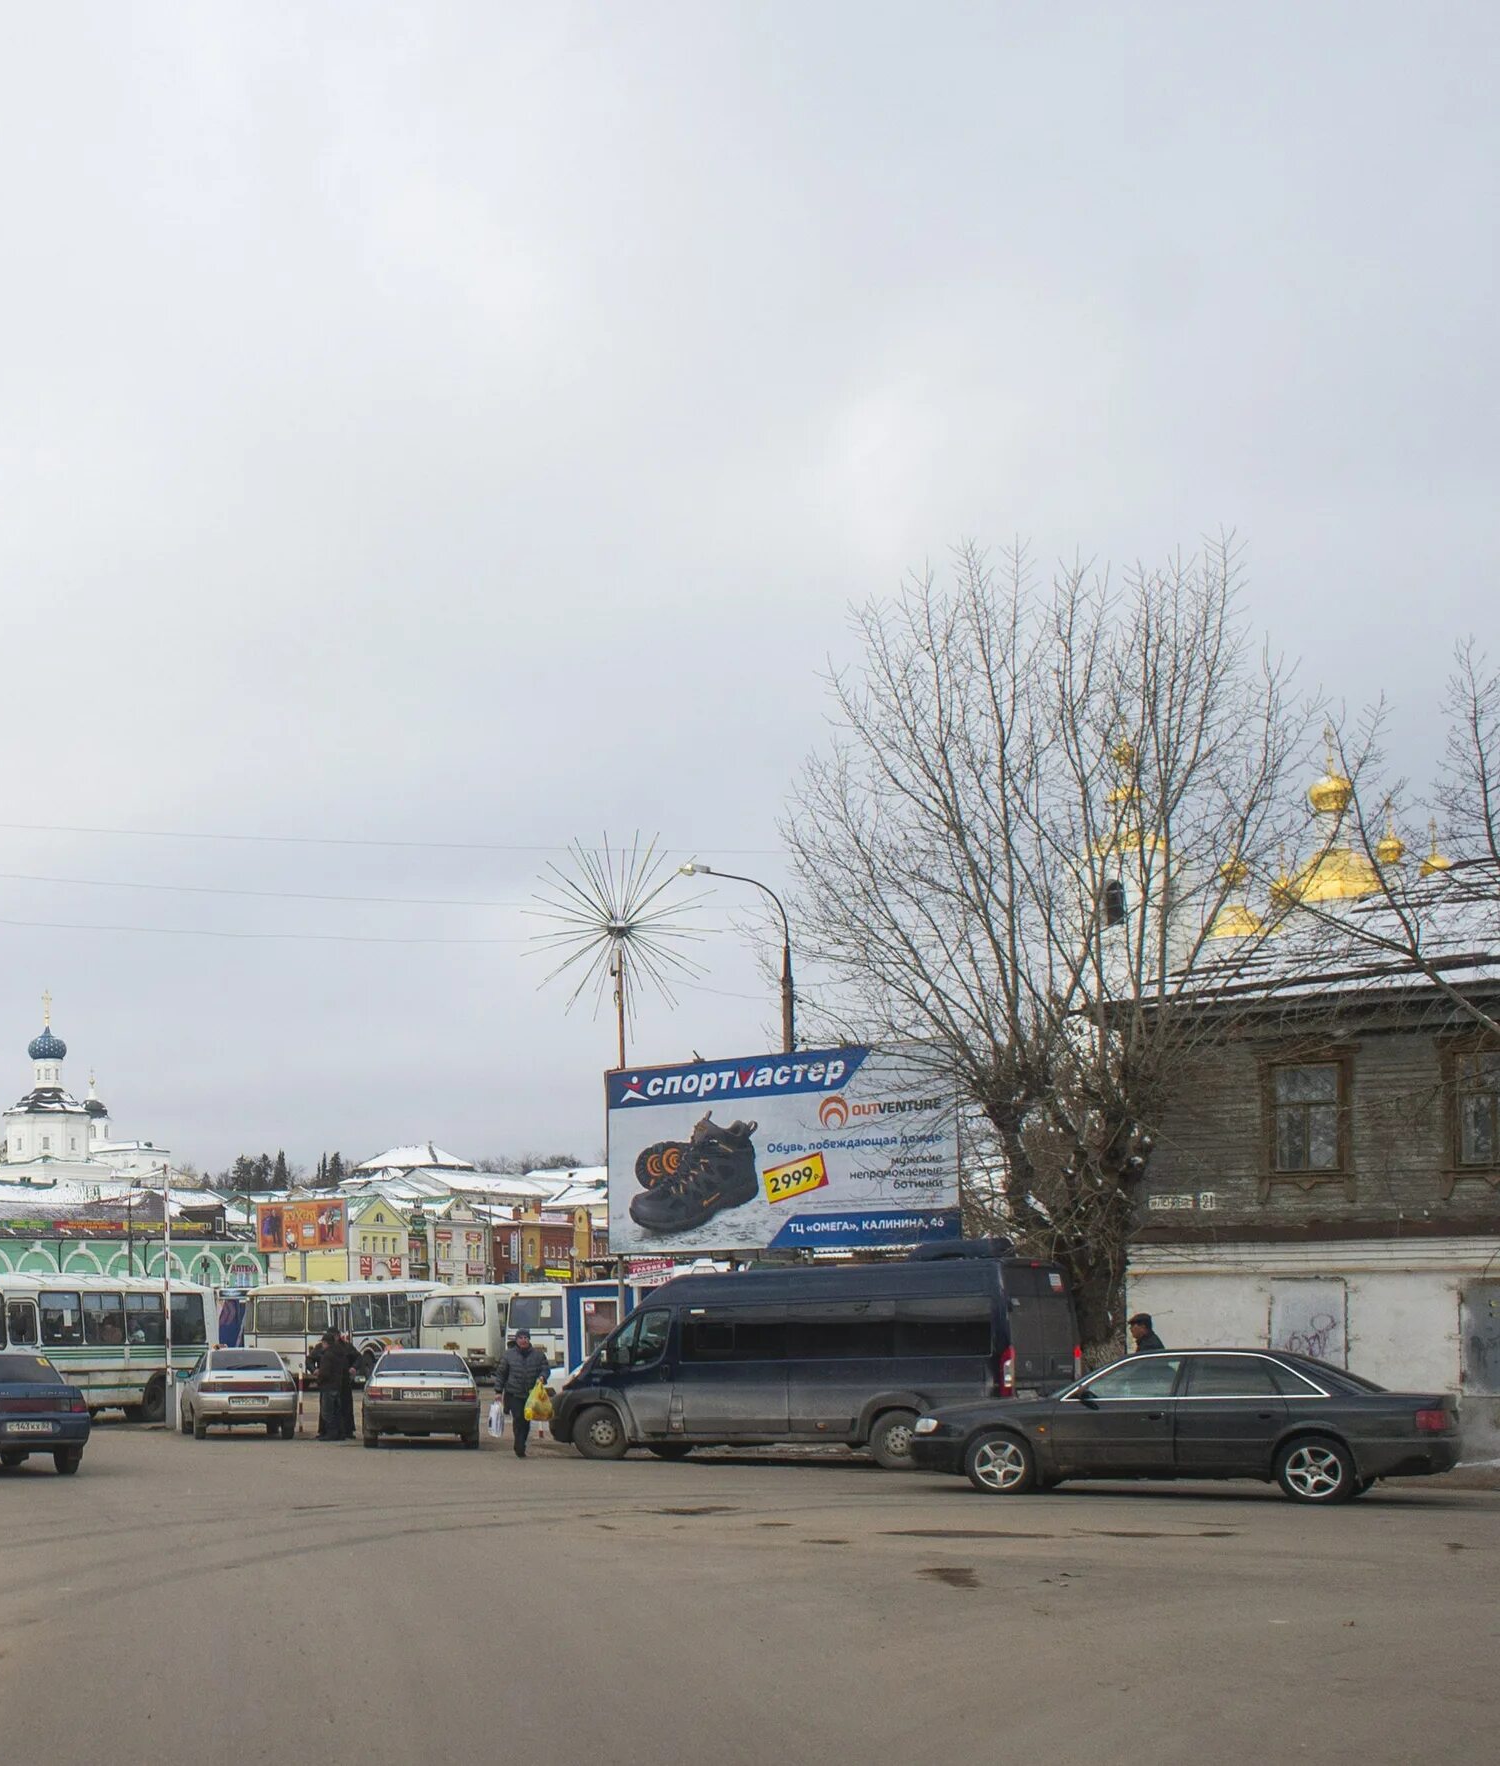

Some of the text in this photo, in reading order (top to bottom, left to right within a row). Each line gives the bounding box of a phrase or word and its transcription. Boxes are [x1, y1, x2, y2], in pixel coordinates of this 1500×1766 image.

[852, 1099, 942, 1116] OUTVENTURE
[767, 1142, 807, 1154] Обувь,
[808, 1136, 897, 1151] побеждающая
[850, 1167, 943, 1180] непромокаемые
[894, 1178, 943, 1190] ботинки
[789, 1223, 804, 1234] ТЦ
[806, 1221, 859, 1232] «ОМЕГА»,
[862, 1219, 929, 1231] КАЛИНИНА,
[231, 1264, 258, 1273] АПТЕКА
